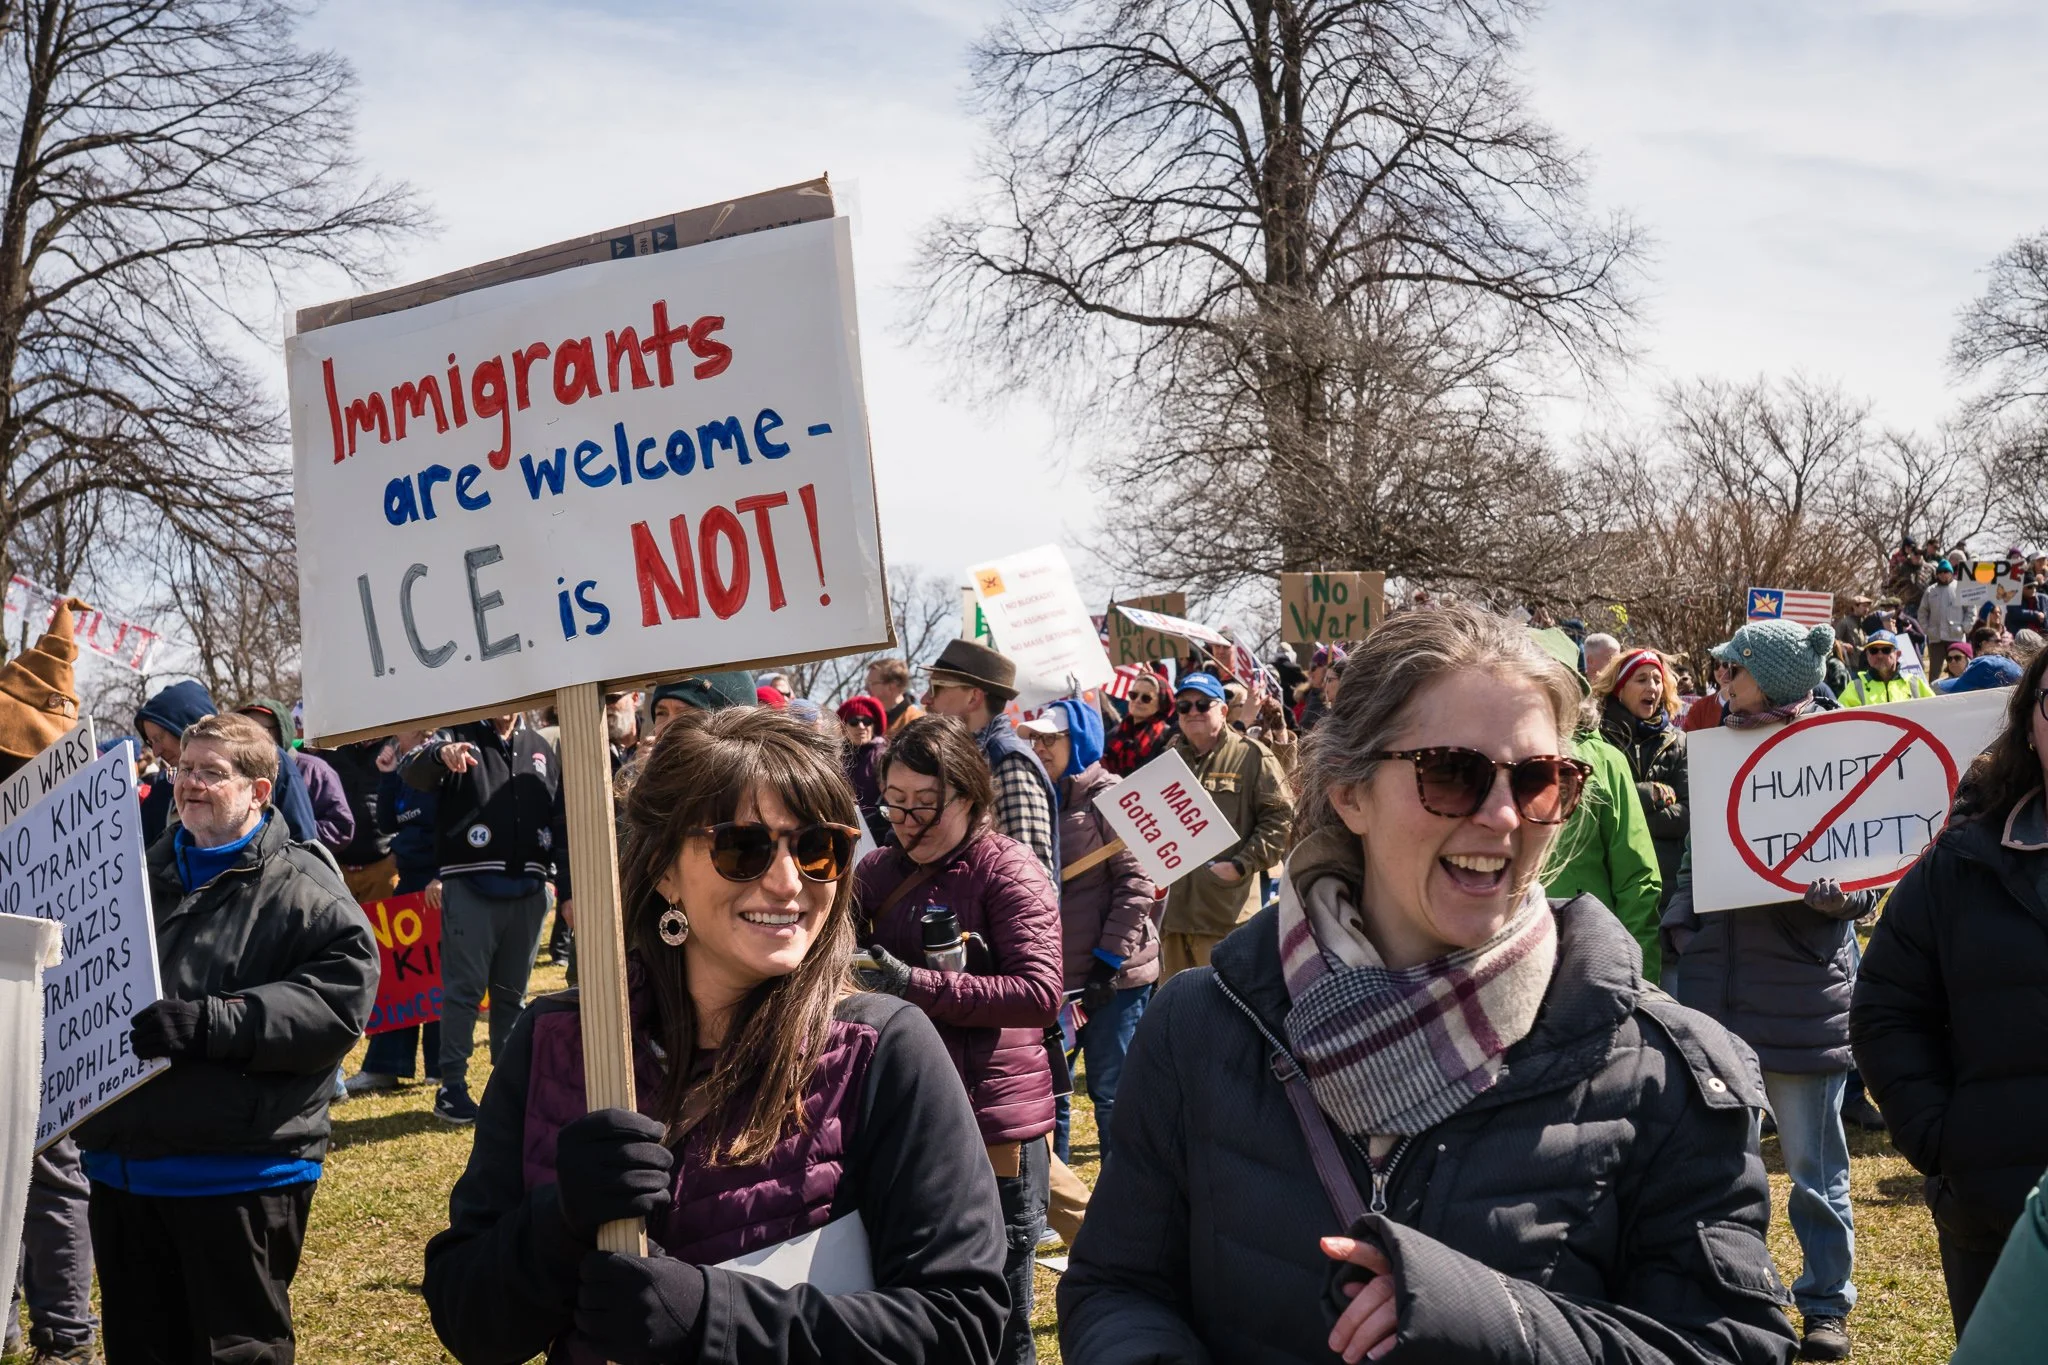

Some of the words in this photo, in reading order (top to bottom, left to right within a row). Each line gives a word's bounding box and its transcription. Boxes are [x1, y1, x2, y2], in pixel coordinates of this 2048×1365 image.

[322, 299, 732, 470] Immigrants
[384, 463, 492, 526] are
[357, 544, 535, 677] I.C.E.
[556, 576, 611, 641] is
[630, 483, 832, 627] NOT!
[1311, 574, 1348, 605] No
[3, 775, 30, 825] NO
[38, 728, 89, 794] WARS
[1752, 747, 1912, 802] HUMPTY
[0, 826, 31, 884] NO
[51, 758, 127, 844] KINGS
[470, 830, 487, 842] 44
[1118, 791, 1162, 843] Gotta
[1156, 841, 1182, 869] Go
[1160, 781, 1209, 838] MAGA
[1752, 810, 1942, 867] TRUMPTY
[27, 810, 123, 899] TYRANTS
[36, 852, 124, 922] FASCISTS
[62, 897, 121, 960] NAZIS
[42, 937, 131, 1019] TRAITORS
[59, 982, 133, 1051] CROOKS
[40, 1030, 129, 1109] PEDOPHILE
[59, 1100, 76, 1126] WE
[79, 1092, 92, 1110] THE
